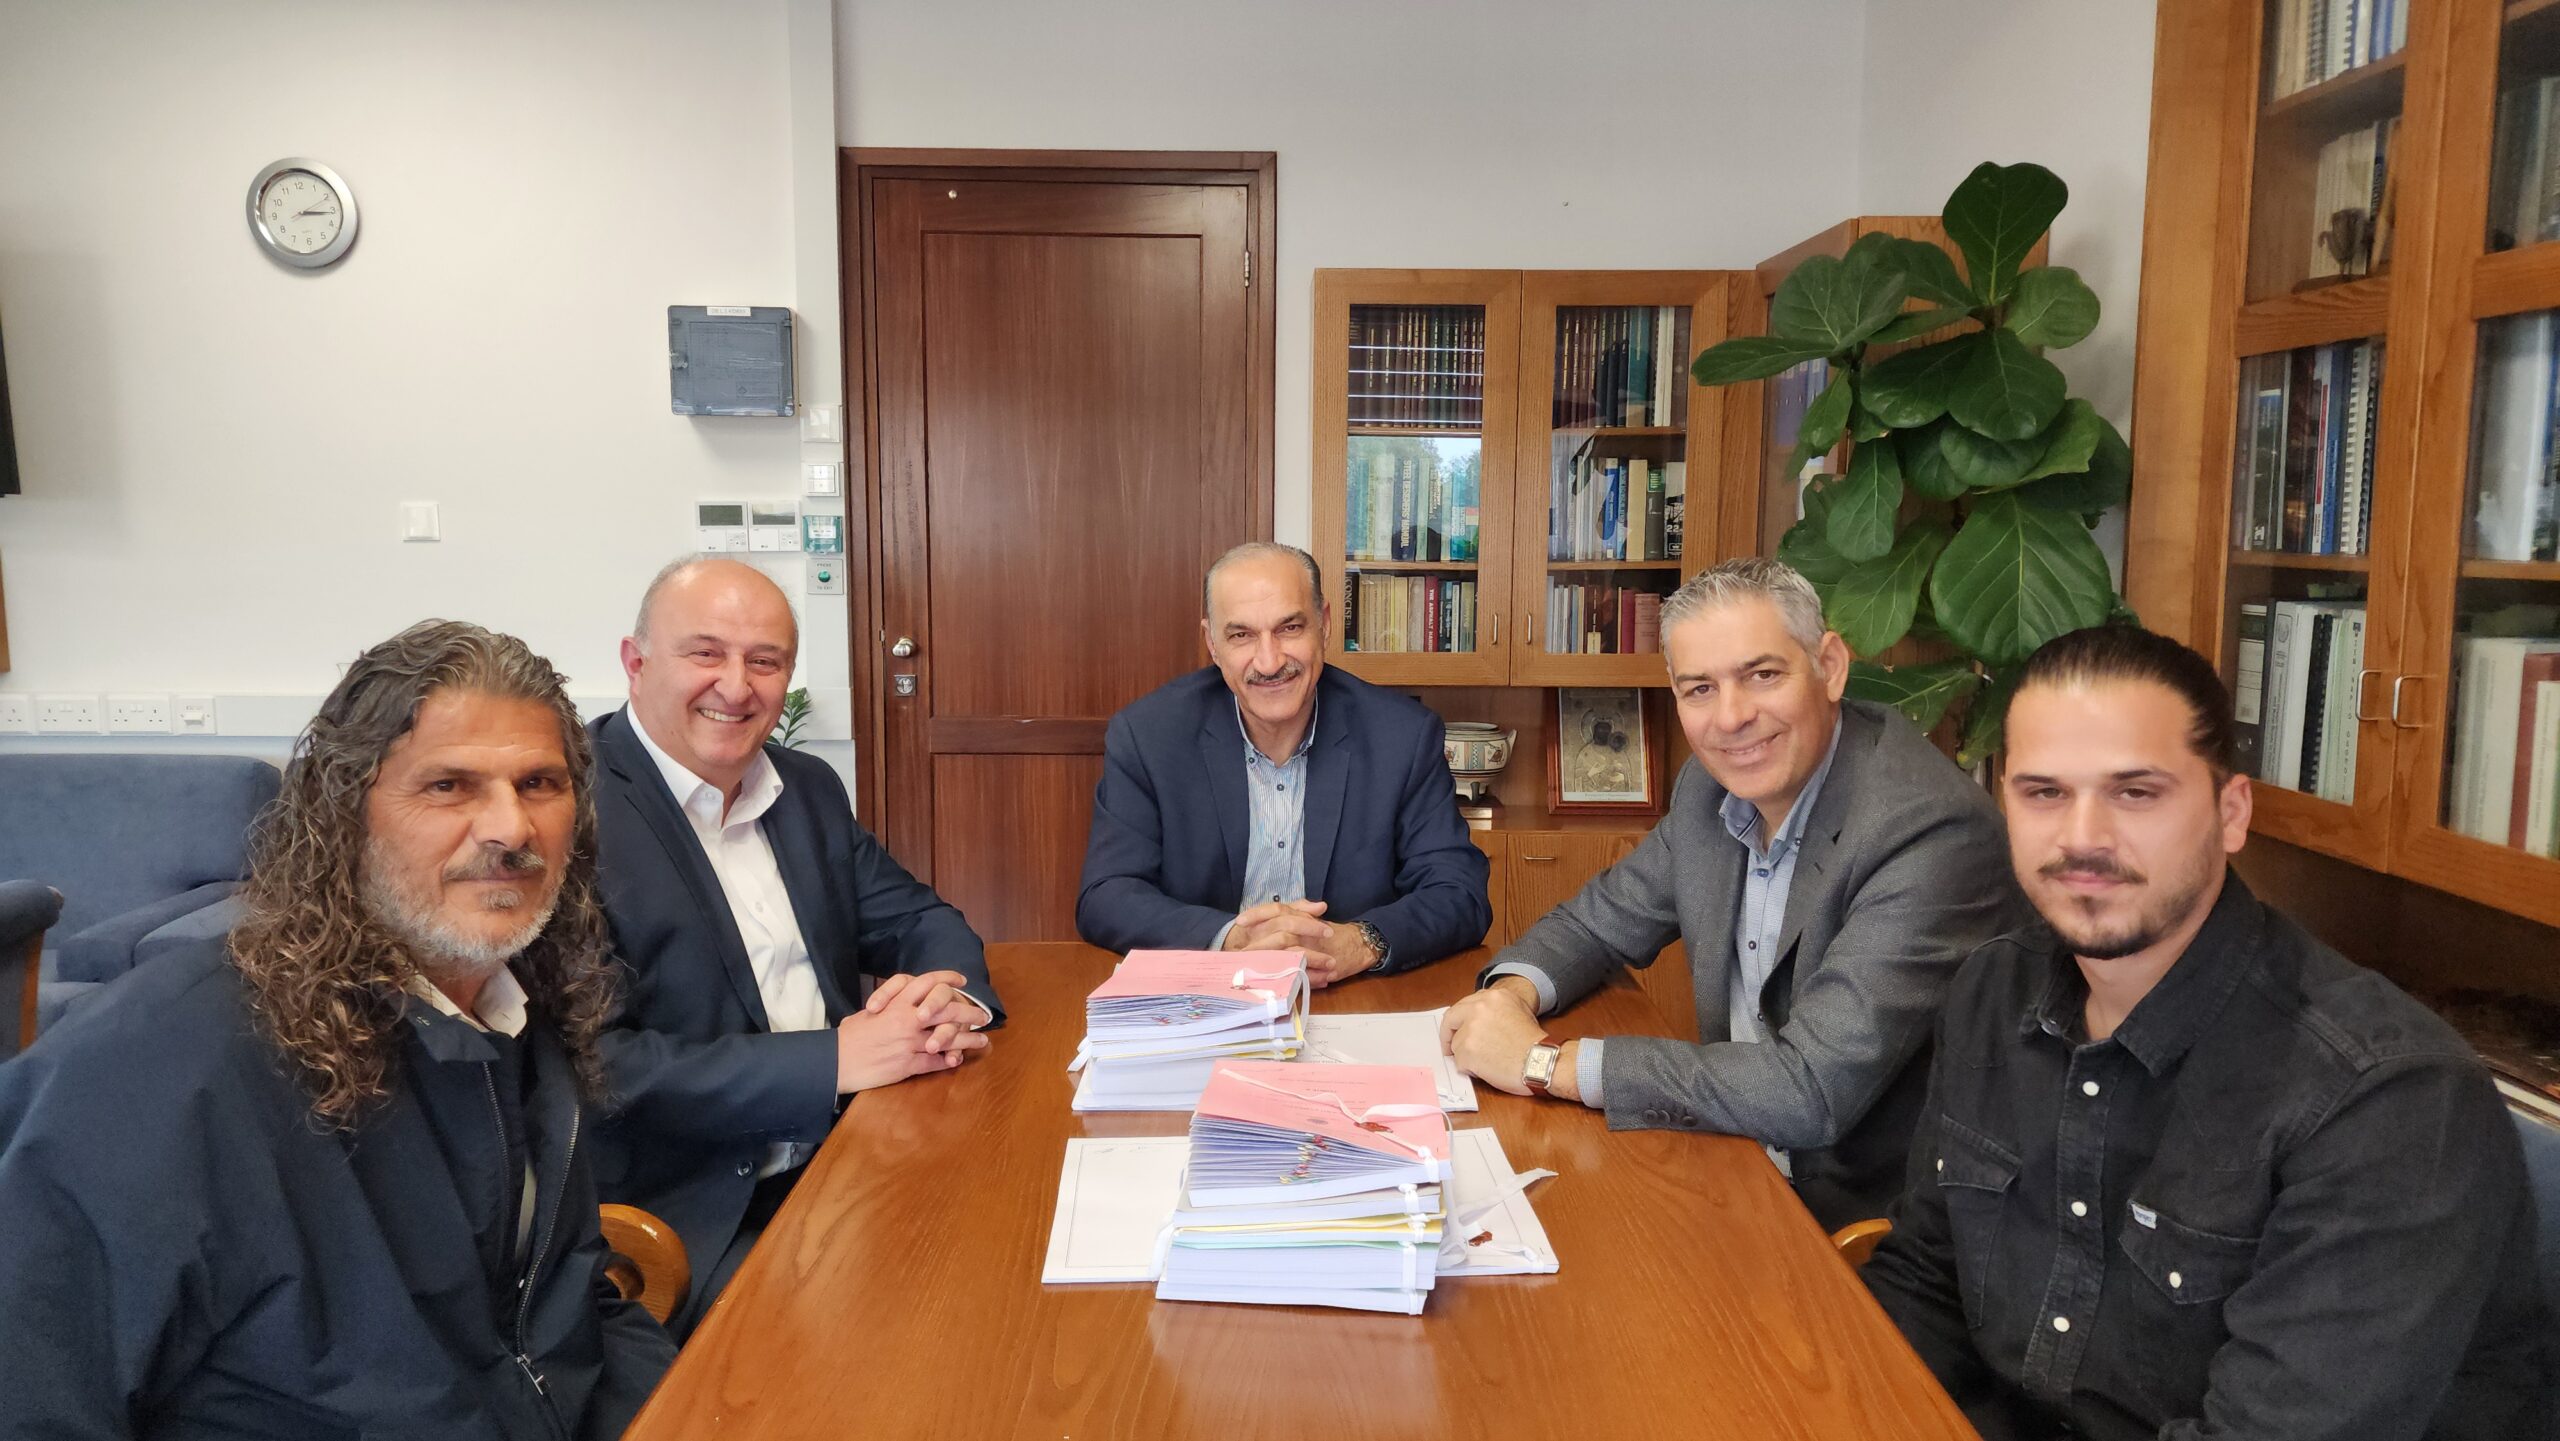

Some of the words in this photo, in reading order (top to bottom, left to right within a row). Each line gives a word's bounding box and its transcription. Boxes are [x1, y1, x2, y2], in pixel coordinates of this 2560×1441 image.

[294, 181, 304, 190] 12
[282, 187, 290, 195] 11
[323, 193, 330, 201] 2
[273, 199, 283, 207] 10
[330, 206, 336, 215] 3
[271, 212, 278, 221] 9
[328, 219, 334, 228] 4
[280, 225, 286, 234] 8
[291, 235, 297, 243] 7
[320, 232, 326, 240] 5
[306, 237, 313, 246] 6
